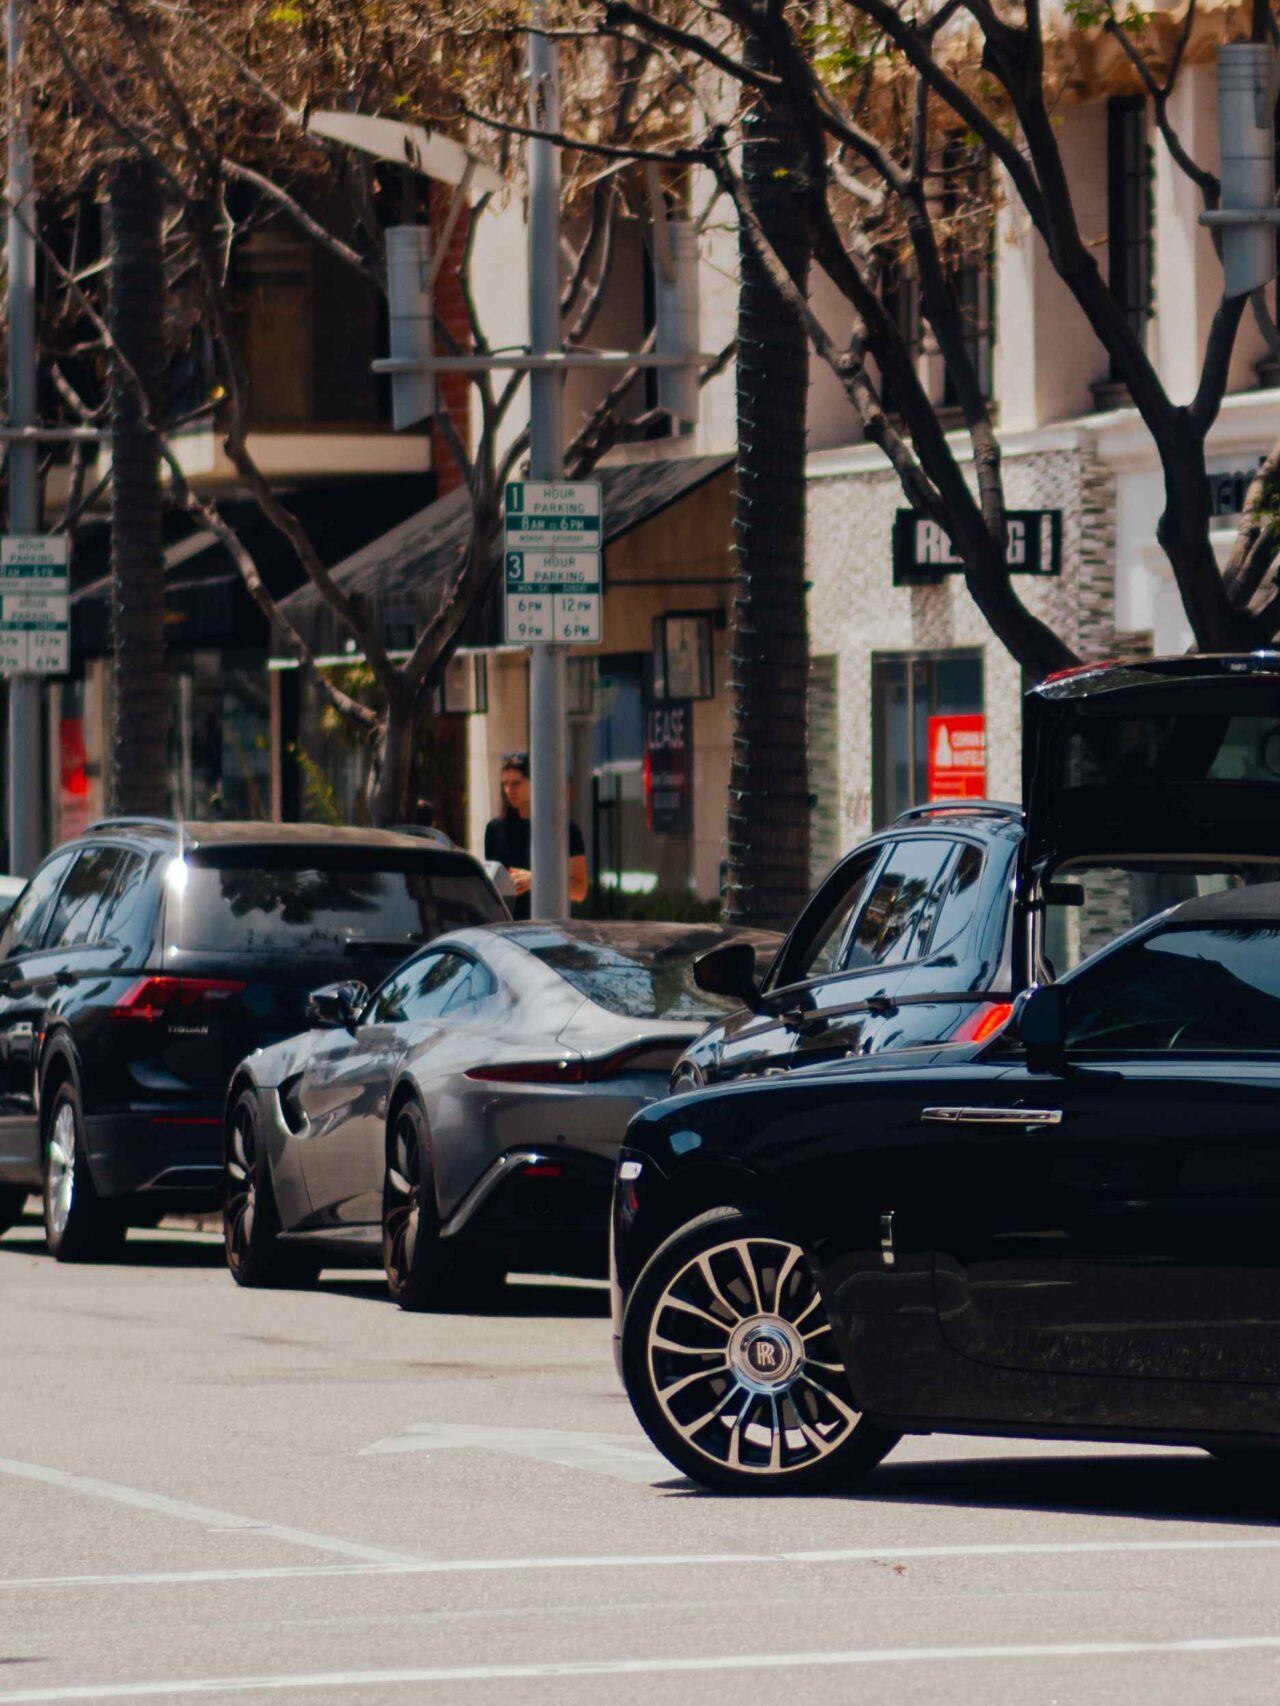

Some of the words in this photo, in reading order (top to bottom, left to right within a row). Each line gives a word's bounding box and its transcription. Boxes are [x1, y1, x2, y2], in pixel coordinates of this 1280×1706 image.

[543, 488, 576, 498] HOUR
[534, 503, 585, 513] PARKING
[509, 555, 521, 578] 3
[543, 557, 576, 567] HOUR
[534, 572, 585, 582] PARKING
